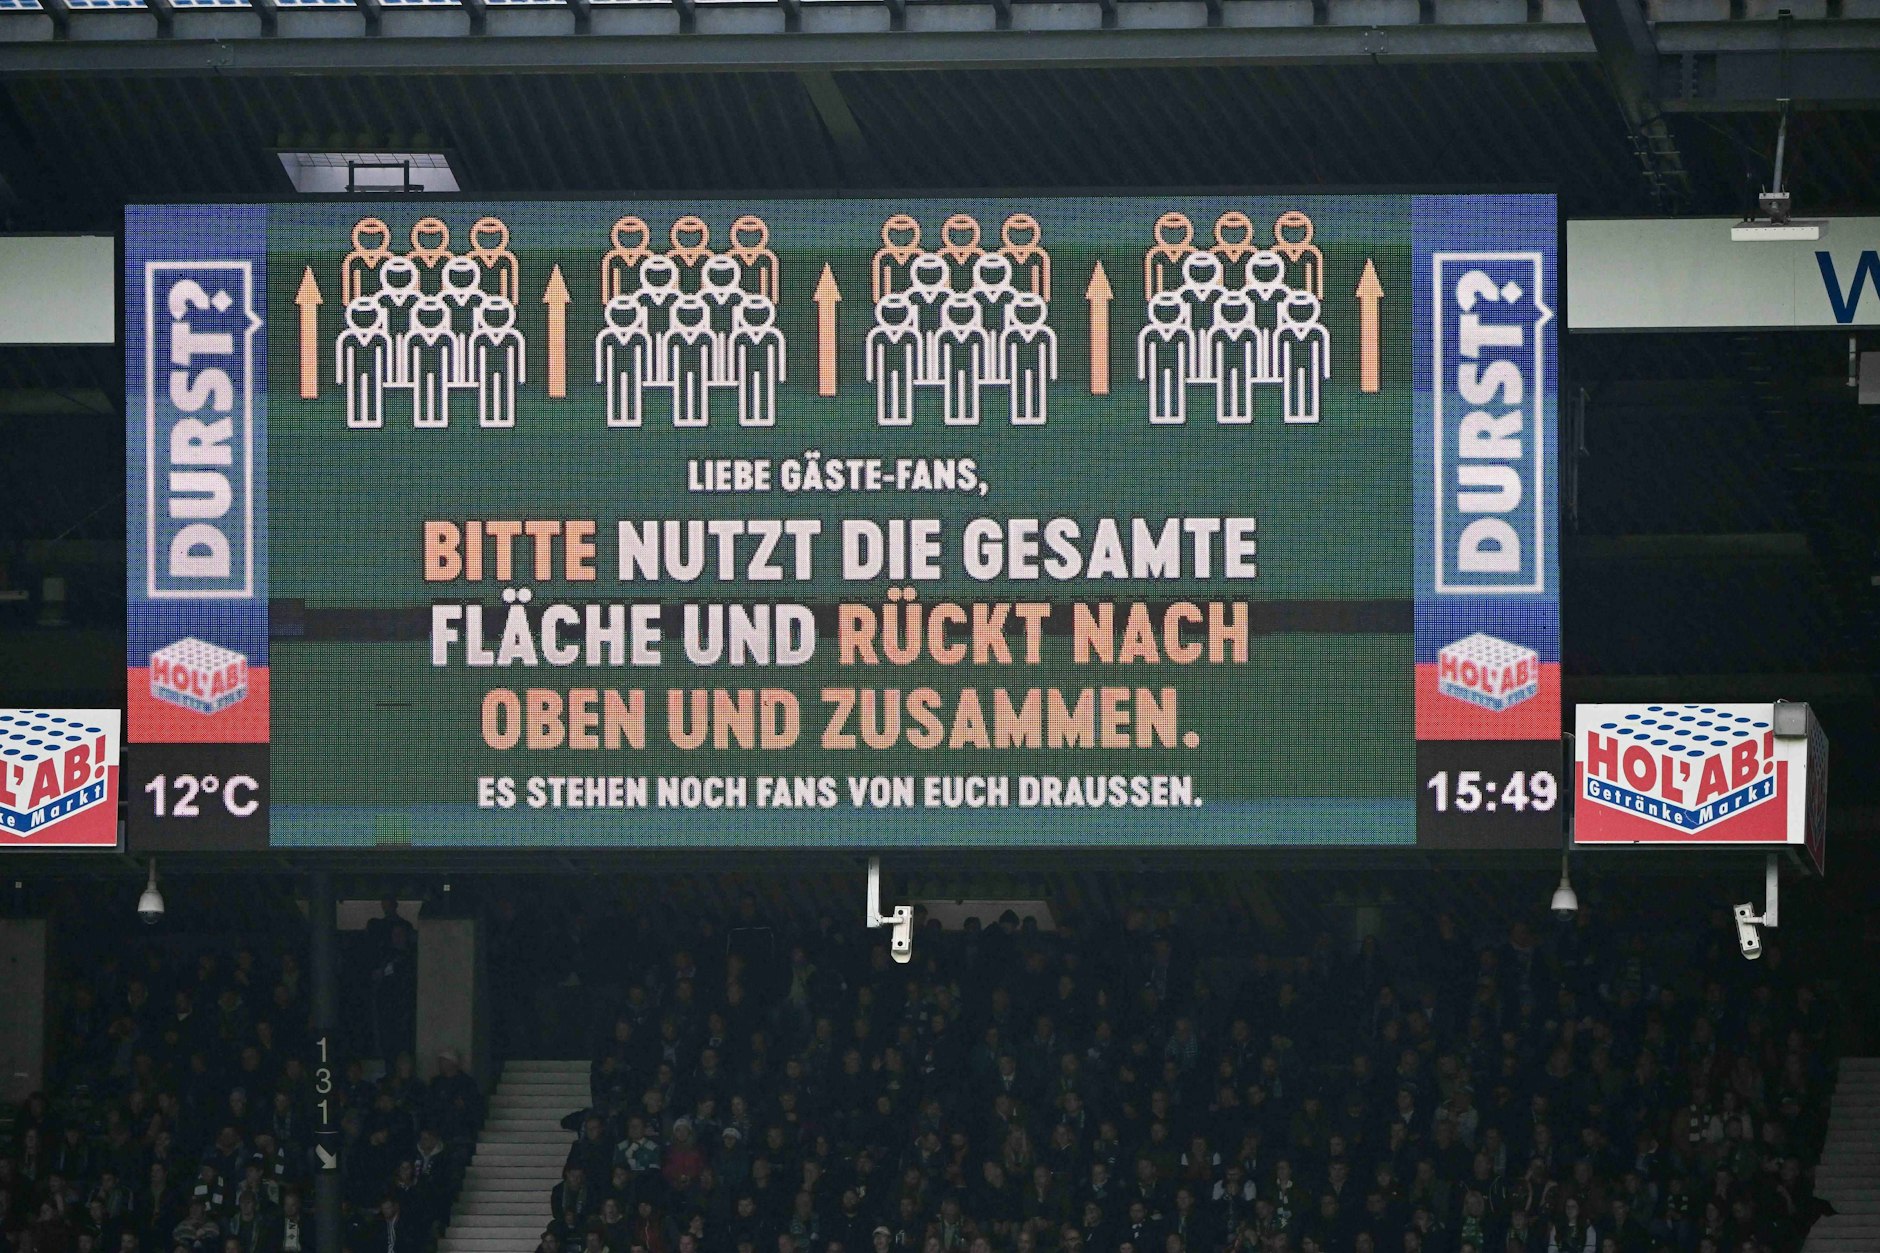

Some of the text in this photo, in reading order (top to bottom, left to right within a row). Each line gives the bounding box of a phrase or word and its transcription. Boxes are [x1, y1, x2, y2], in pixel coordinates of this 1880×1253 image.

[168, 279, 233, 577] DURST?
[1456, 270, 1524, 572] DURST?
[688, 451, 989, 496] LIEBE GÄSTE-FANS,
[424, 517, 1256, 580] BITTE NUTZT DIE GESAMTE
[432, 586, 1248, 666] FLÄCHE UND RÜCKT NACH
[481, 687, 1200, 750] OBEN UND ZUSAMMEN.
[478, 776, 1203, 808] ES STEHEN NOCH FANS VON EUCH DRAUSSEN.
[1427, 770, 1558, 812] 15:49
[1588, 729, 1774, 806] HOL'AB!
[30, 784, 102, 827] Markt
[145, 774, 259, 816] 12°C
[1588, 780, 1684, 825] Getränke
[1699, 780, 1772, 824] Markt
